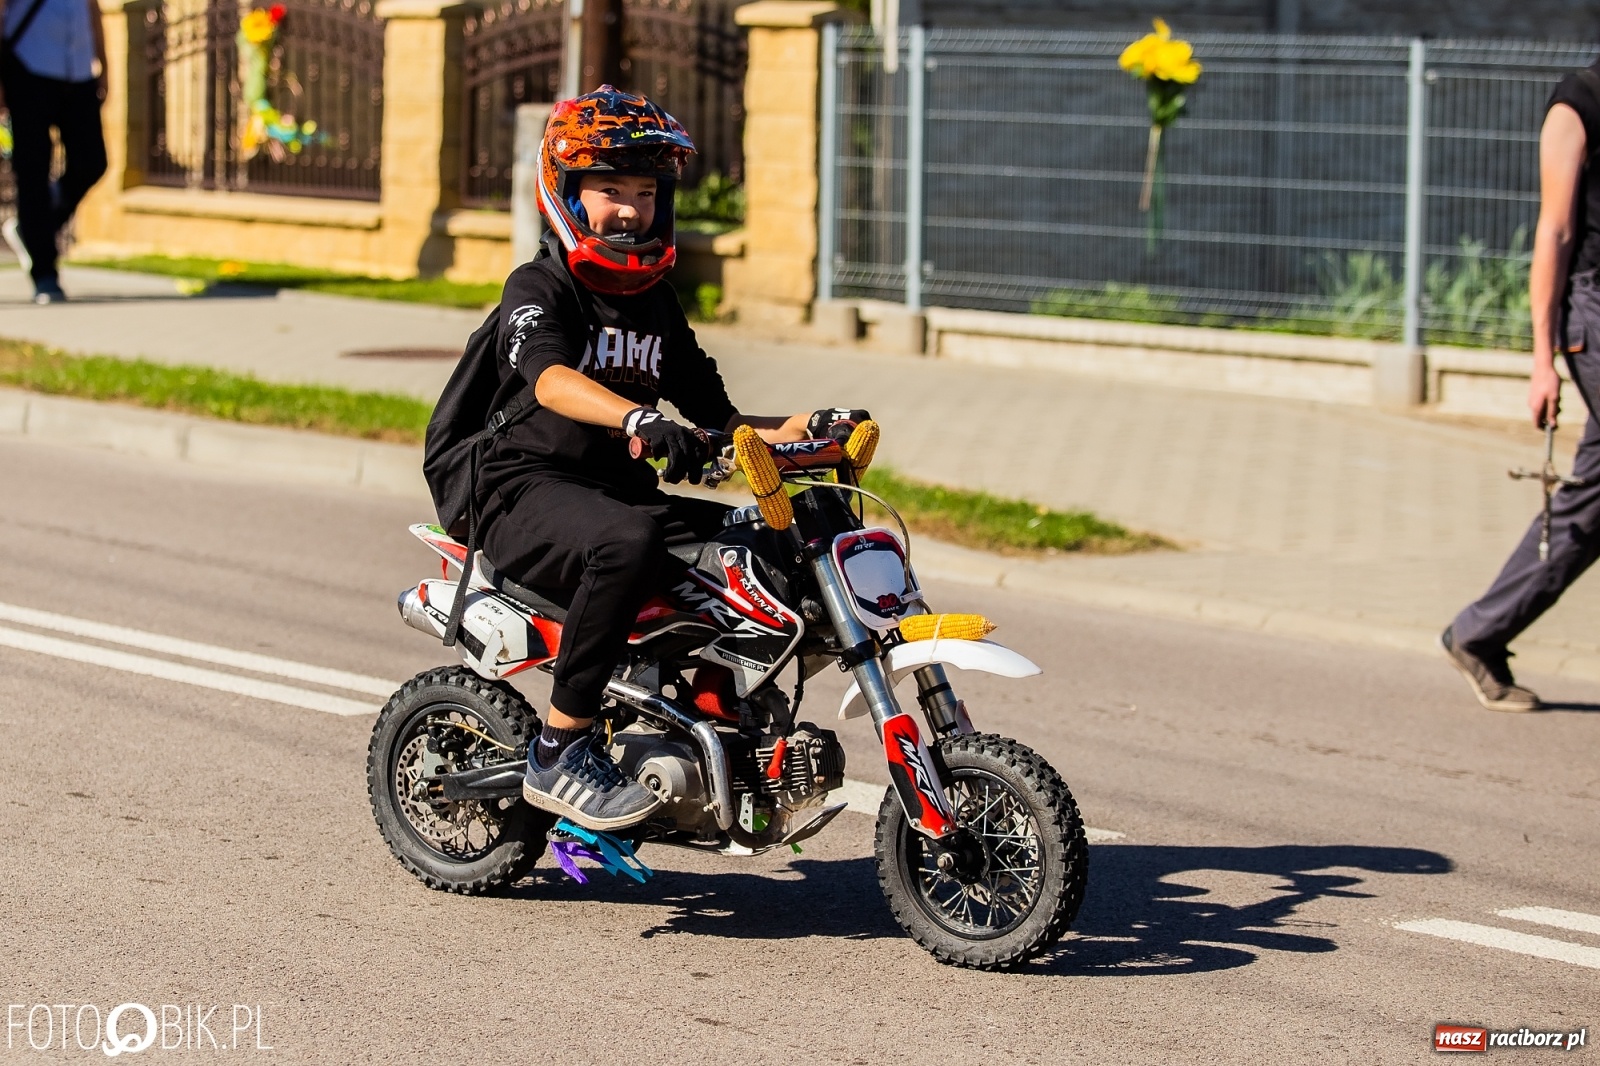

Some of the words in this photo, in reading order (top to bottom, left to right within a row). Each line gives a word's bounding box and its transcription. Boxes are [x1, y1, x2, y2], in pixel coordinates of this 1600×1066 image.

[775, 440, 830, 454] MRF
[671, 580, 791, 637] MRF
[739, 577, 788, 625] RUNNER
[898, 737, 946, 818] MRF
